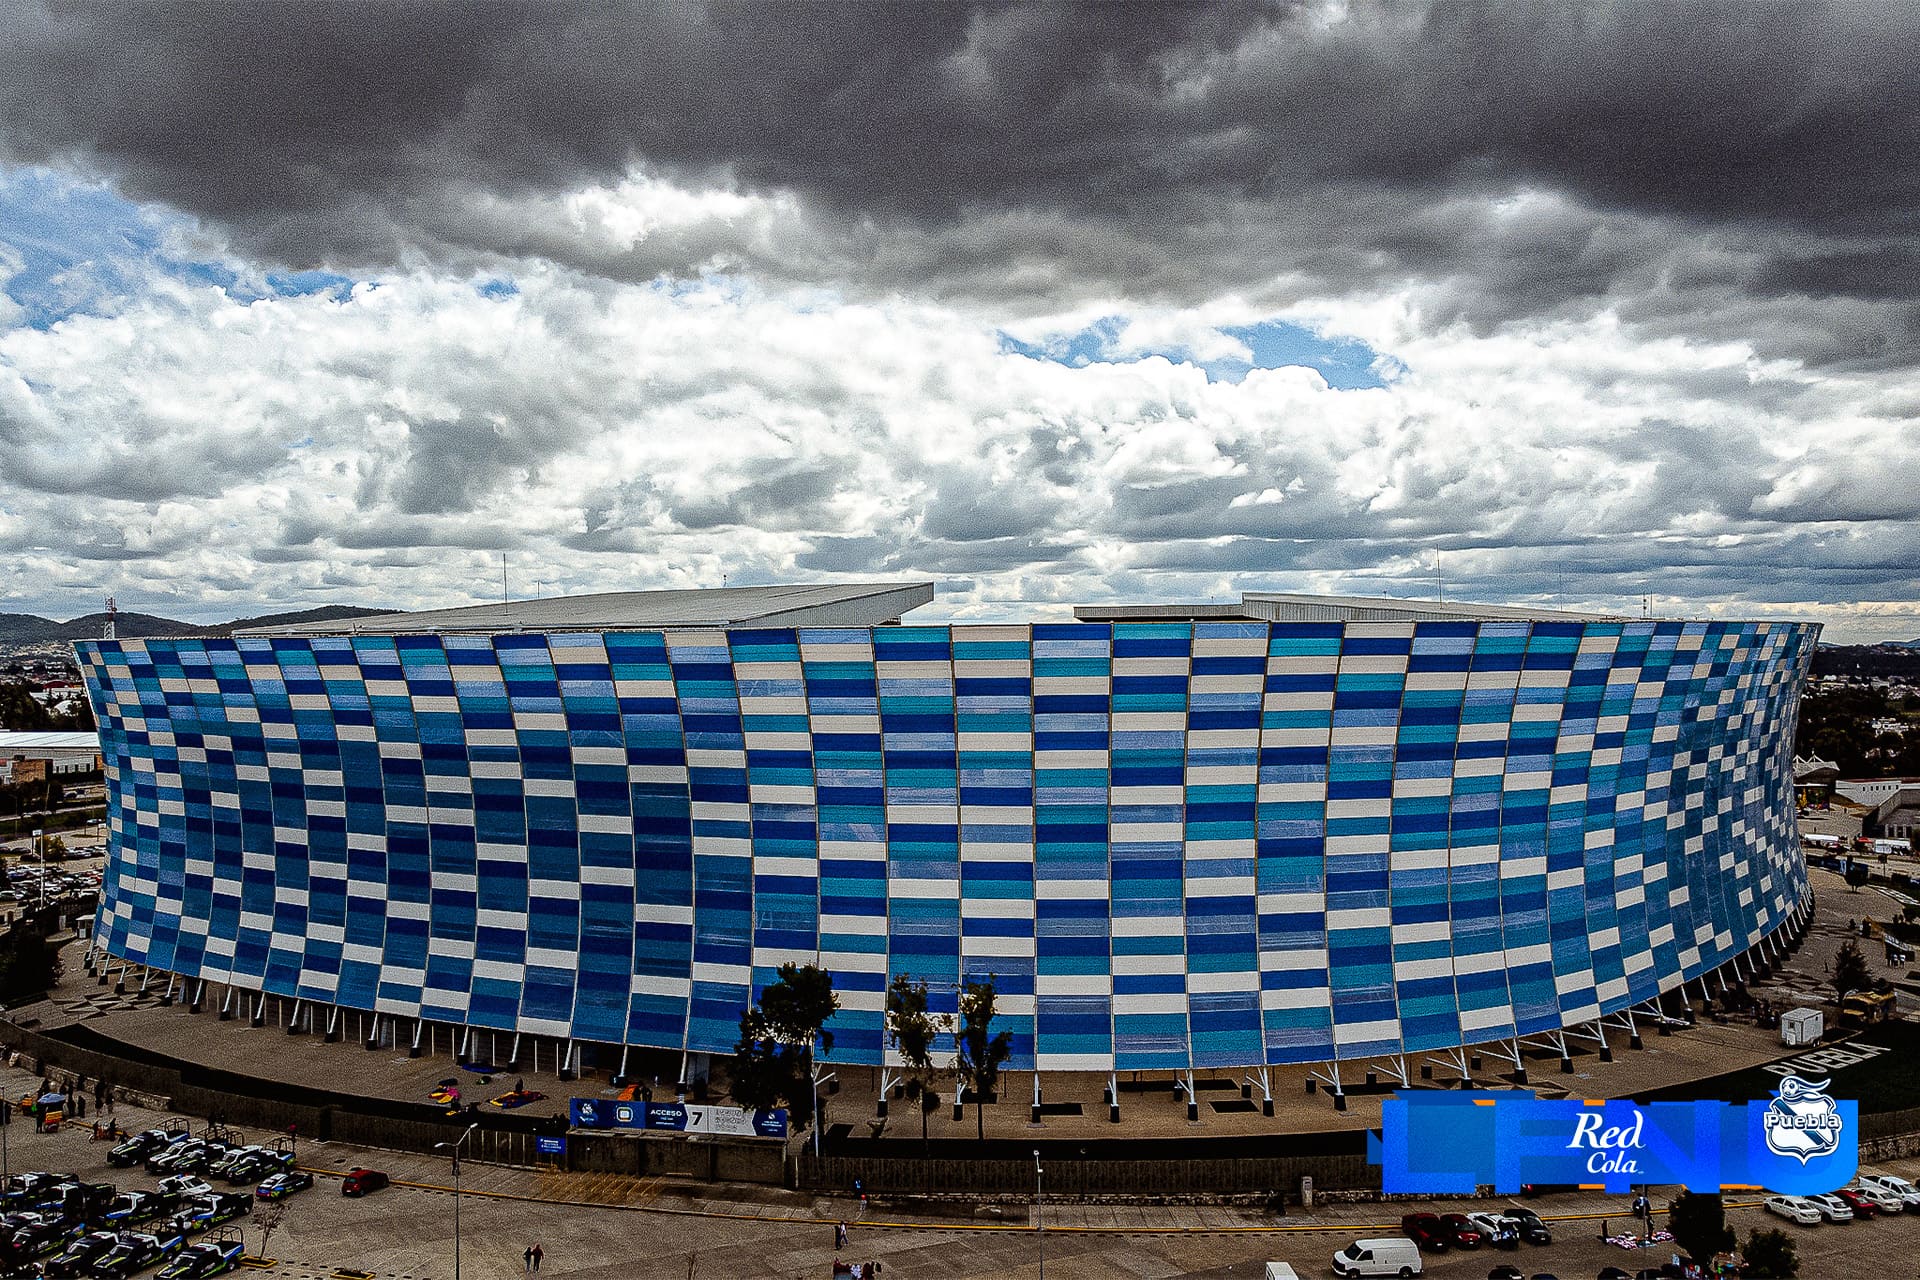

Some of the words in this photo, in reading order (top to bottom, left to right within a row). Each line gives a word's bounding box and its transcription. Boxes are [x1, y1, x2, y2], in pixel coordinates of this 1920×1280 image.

[1762, 1041, 1892, 1077] PUEBLA
[650, 1109, 682, 1117] ACCESO
[692, 1112, 703, 1126] 7
